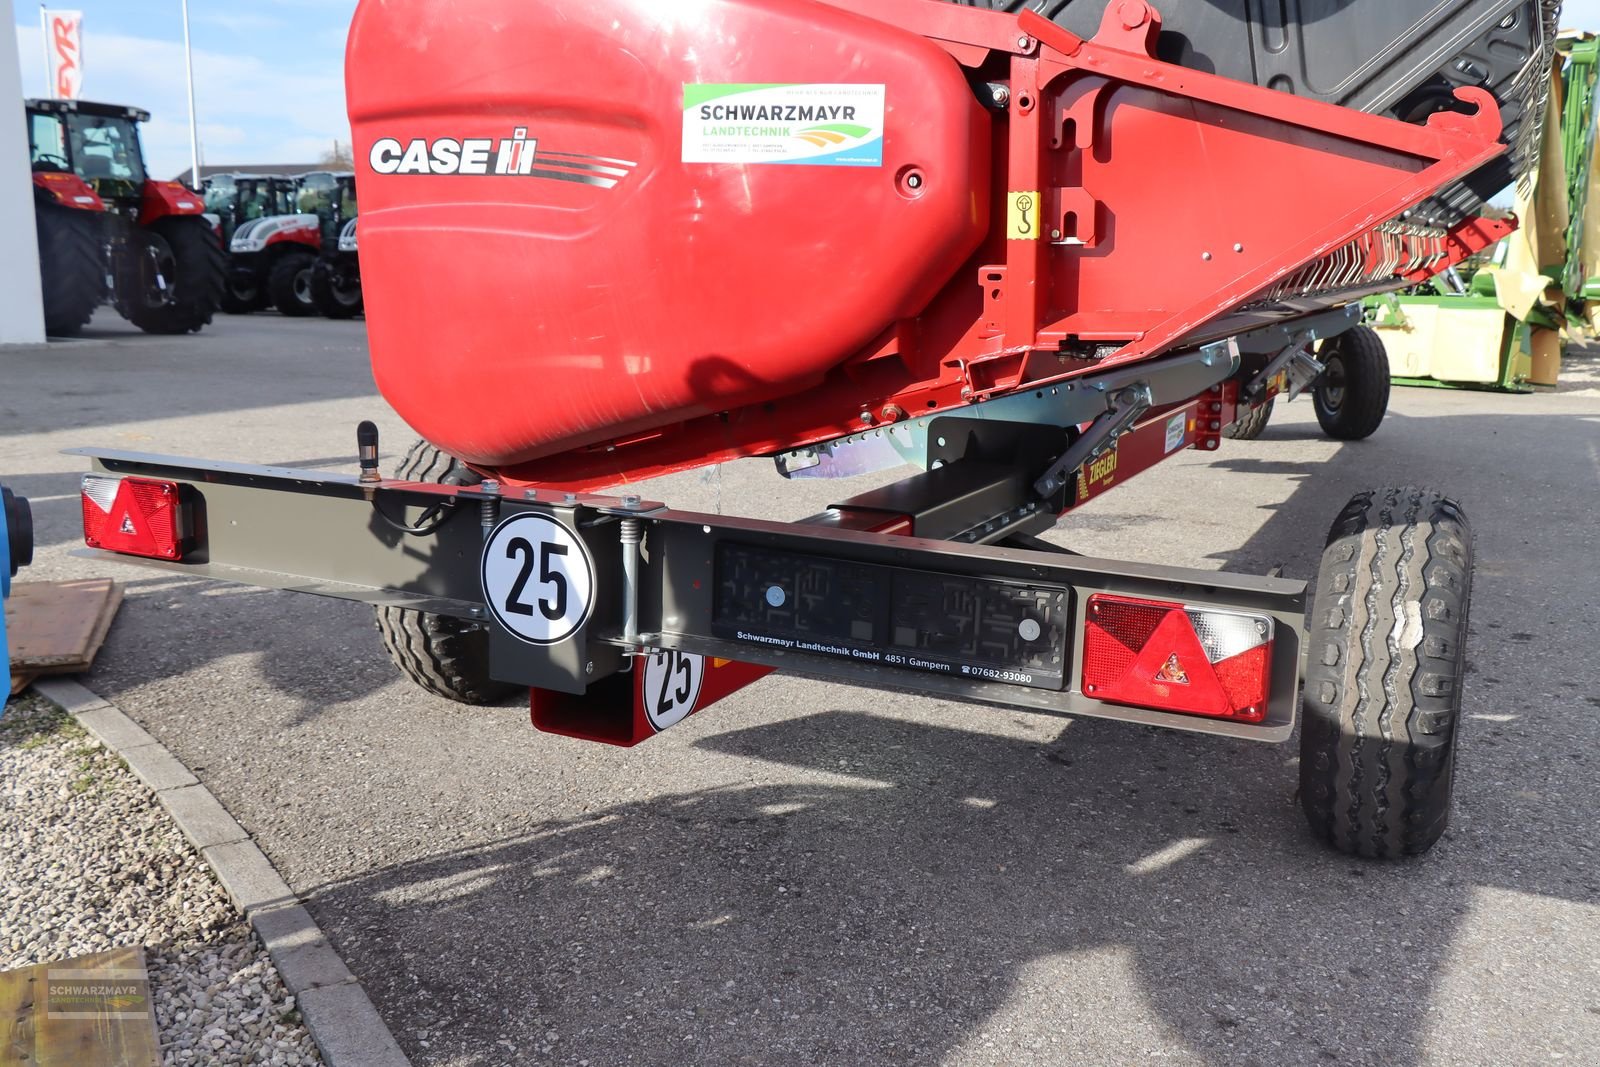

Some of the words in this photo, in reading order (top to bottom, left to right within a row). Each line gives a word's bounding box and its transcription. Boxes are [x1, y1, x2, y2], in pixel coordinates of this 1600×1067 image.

[700, 104, 856, 121] SCHWARZMAYR
[703, 126, 791, 137] LANDTECHNIK
[369, 137, 492, 175] CASE
[1089, 454, 1115, 484] ZIEGLER
[505, 536, 569, 621] 25
[737, 631, 795, 648] Schwarzmayr
[796, 640, 850, 656] Landtechnik
[852, 649, 880, 661] GmbH
[884, 654, 906, 665] 4851
[909, 657, 950, 672] Gampern
[971, 666, 1032, 683] 07682-93080
[657, 650, 692, 716] 25
